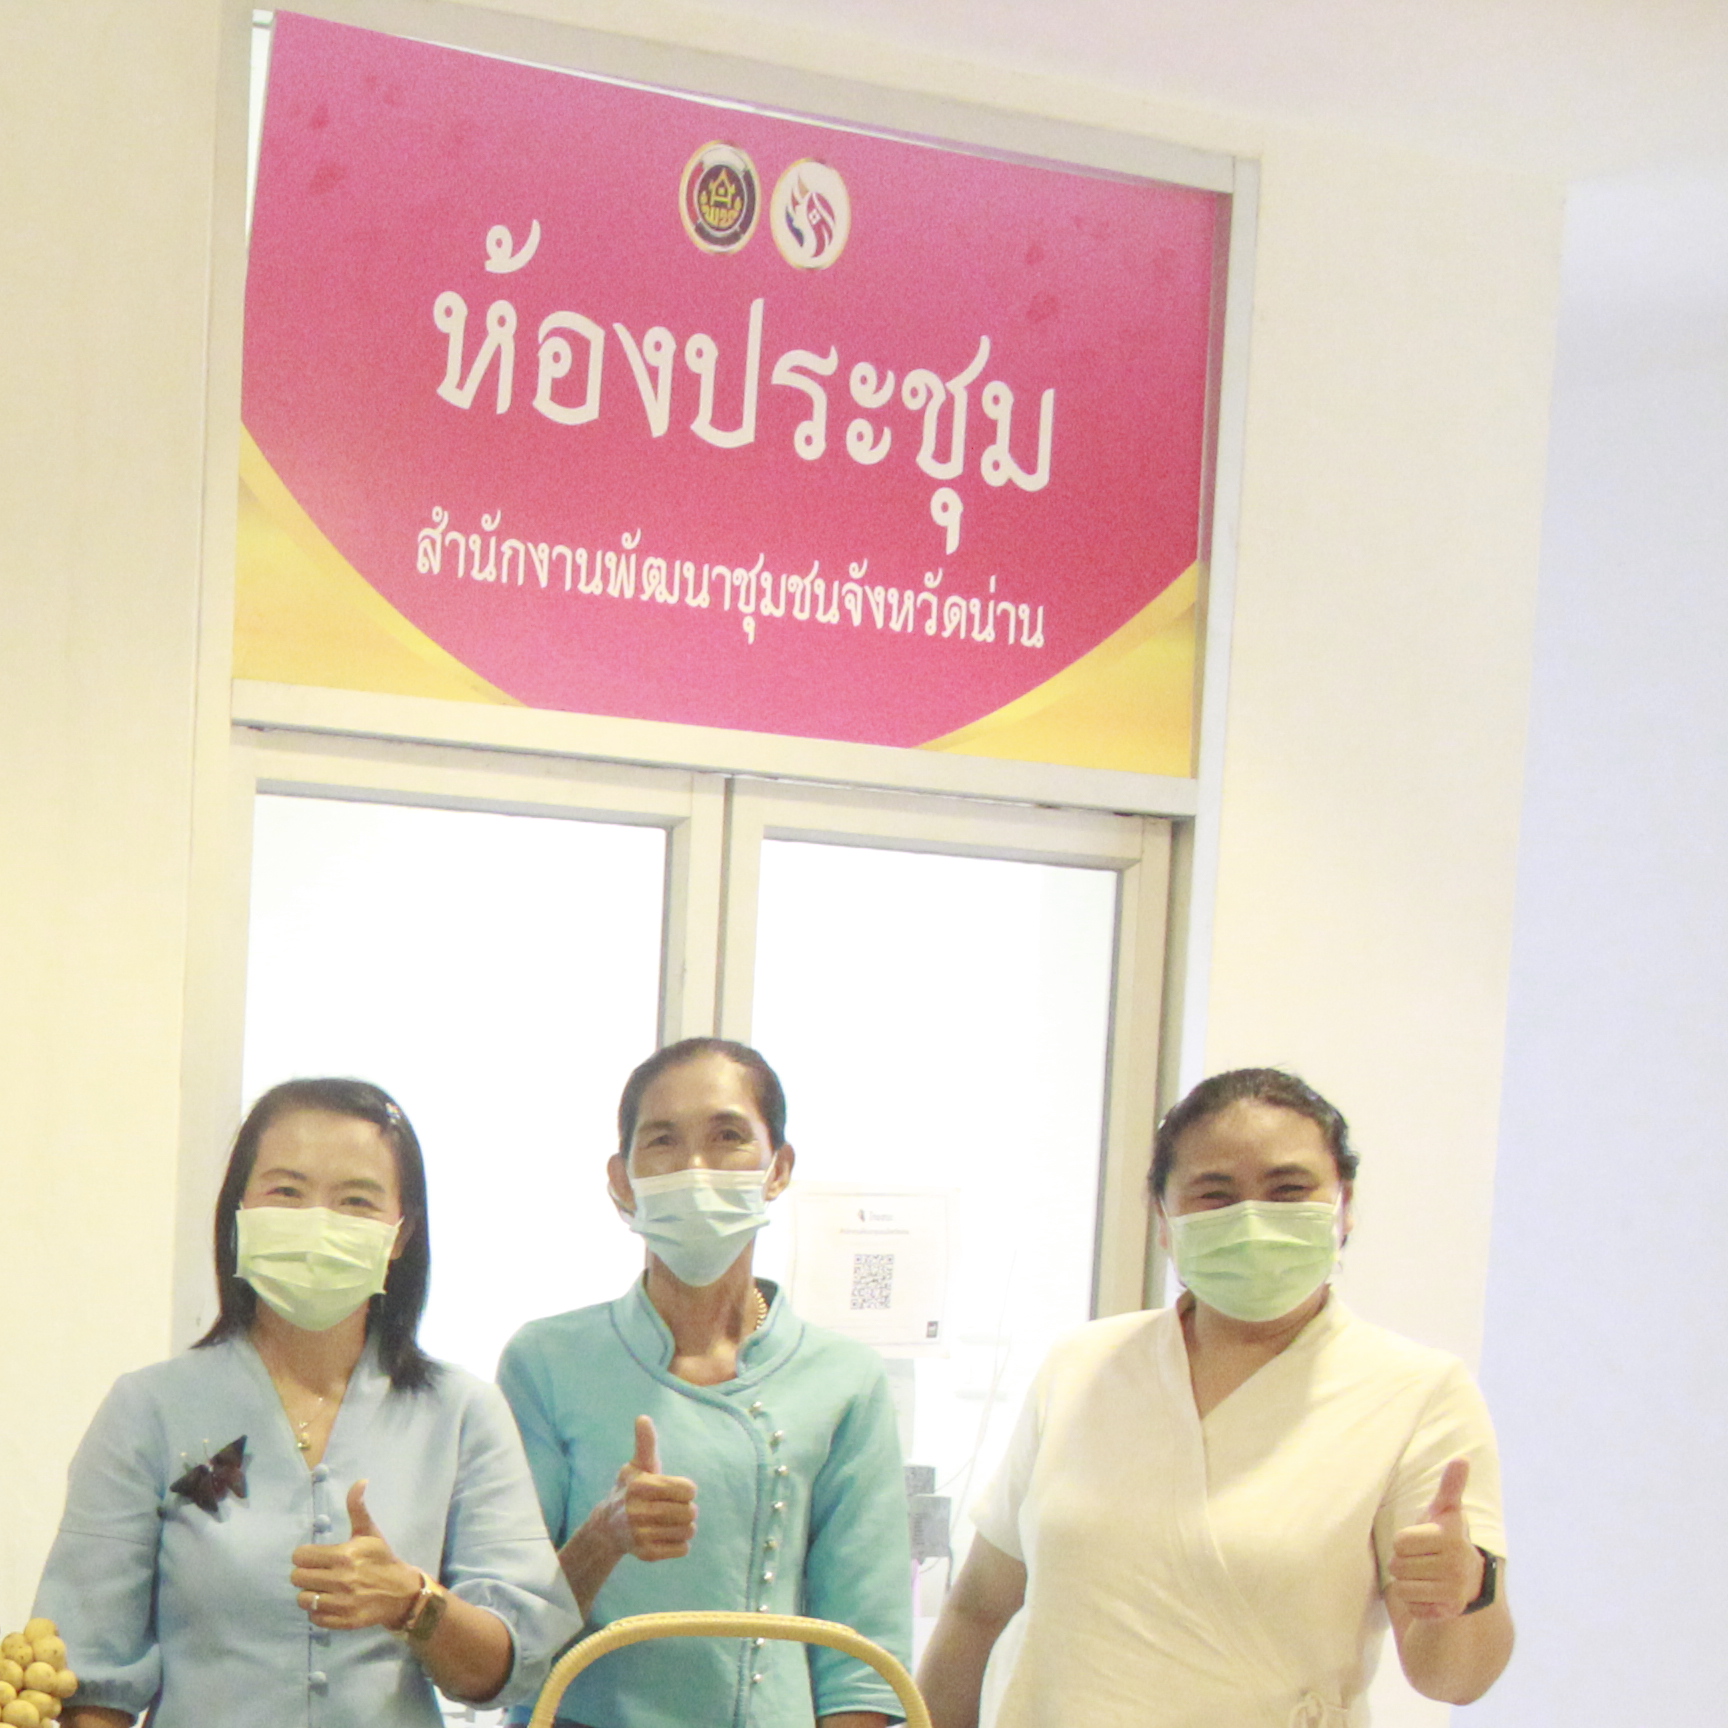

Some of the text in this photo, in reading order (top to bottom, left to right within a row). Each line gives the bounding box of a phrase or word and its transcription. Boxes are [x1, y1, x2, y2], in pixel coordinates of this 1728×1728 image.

[432, 218, 1057, 556] ห้องประชุม
[415, 505, 1047, 649] สำนักงานพัฒนาชุมชนจังหวัดน่าน
